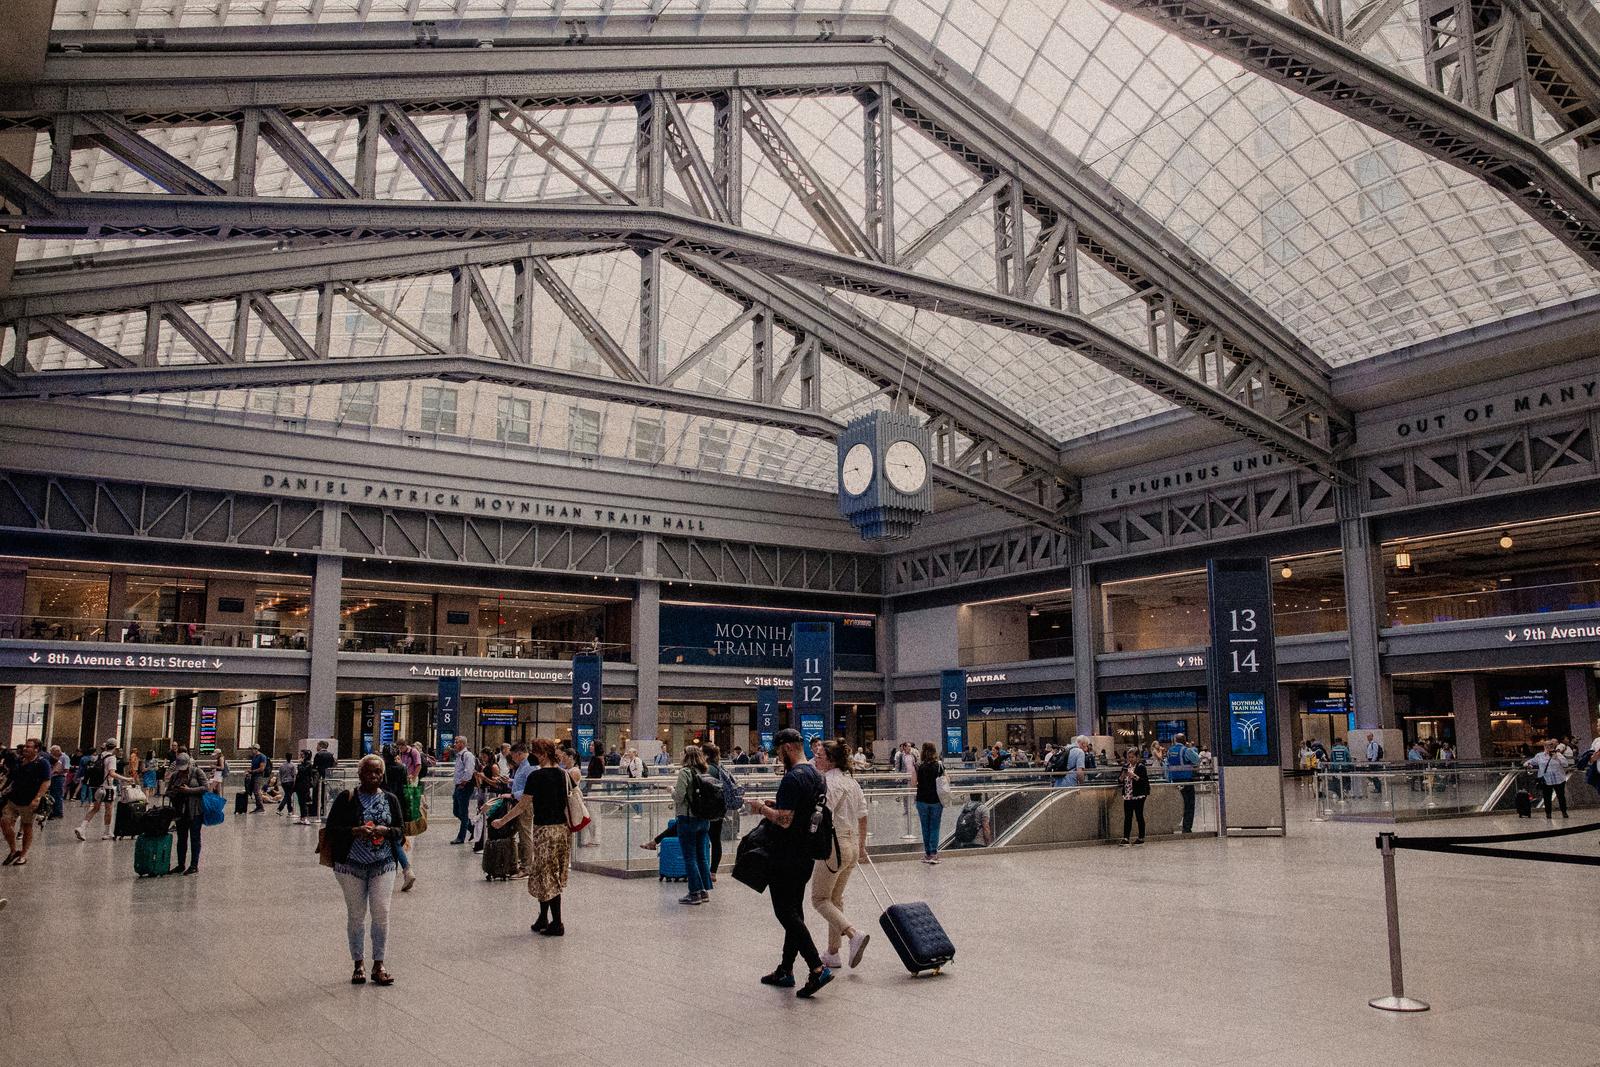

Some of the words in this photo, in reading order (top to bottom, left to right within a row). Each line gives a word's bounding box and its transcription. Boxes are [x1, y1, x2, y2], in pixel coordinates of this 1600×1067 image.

[1397, 415, 1446, 437] OUT
[1464, 404, 1494, 422] OF
[1514, 381, 1597, 412] MANY
[1111, 488, 1118, 499] E
[1129, 466, 1219, 495] PLURIBUS
[263, 474, 349, 495] DANIEL
[364, 485, 461, 508] PATRICK
[474, 497, 582, 518] MOYNIHAN
[594, 509, 651, 526] TRAIN
[662, 517, 705, 531] HALL
[1229, 608, 1257, 632] 13
[715, 623, 793, 640] MOYNIH
[1523, 628, 1546, 640] 9th
[1550, 626, 1600, 639] Avenue
[713, 640, 766, 656] TRAIN
[772, 643, 793, 657] HA
[47, 653, 70, 664] 8th
[73, 654, 121, 666] Avenue
[125, 655, 135, 666] &
[138, 656, 165, 667] 31st
[168, 657, 207, 668] Street
[804, 657, 820, 674] 11
[1188, 655, 1204, 666] 9th
[1229, 649, 1260, 673] 14
[423, 666, 462, 677] Amtrak
[464, 667, 526, 679] Metropolitan
[528, 669, 563, 682] Lounge
[966, 674, 1006, 683] AMTRAK
[582, 681, 591, 694] 9
[754, 677, 772, 686] 31st
[773, 678, 793, 686] Stree
[803, 685, 822, 702] 12
[949, 691, 957, 702] 9
[444, 696, 452, 707] 7
[764, 703, 770, 712] 7
[367, 704, 373, 714] 5
[580, 702, 593, 715] 10
[948, 708, 960, 720] 10
[366, 719, 373, 728] 6
[444, 712, 451, 723] 8
[764, 717, 771, 727] 8
